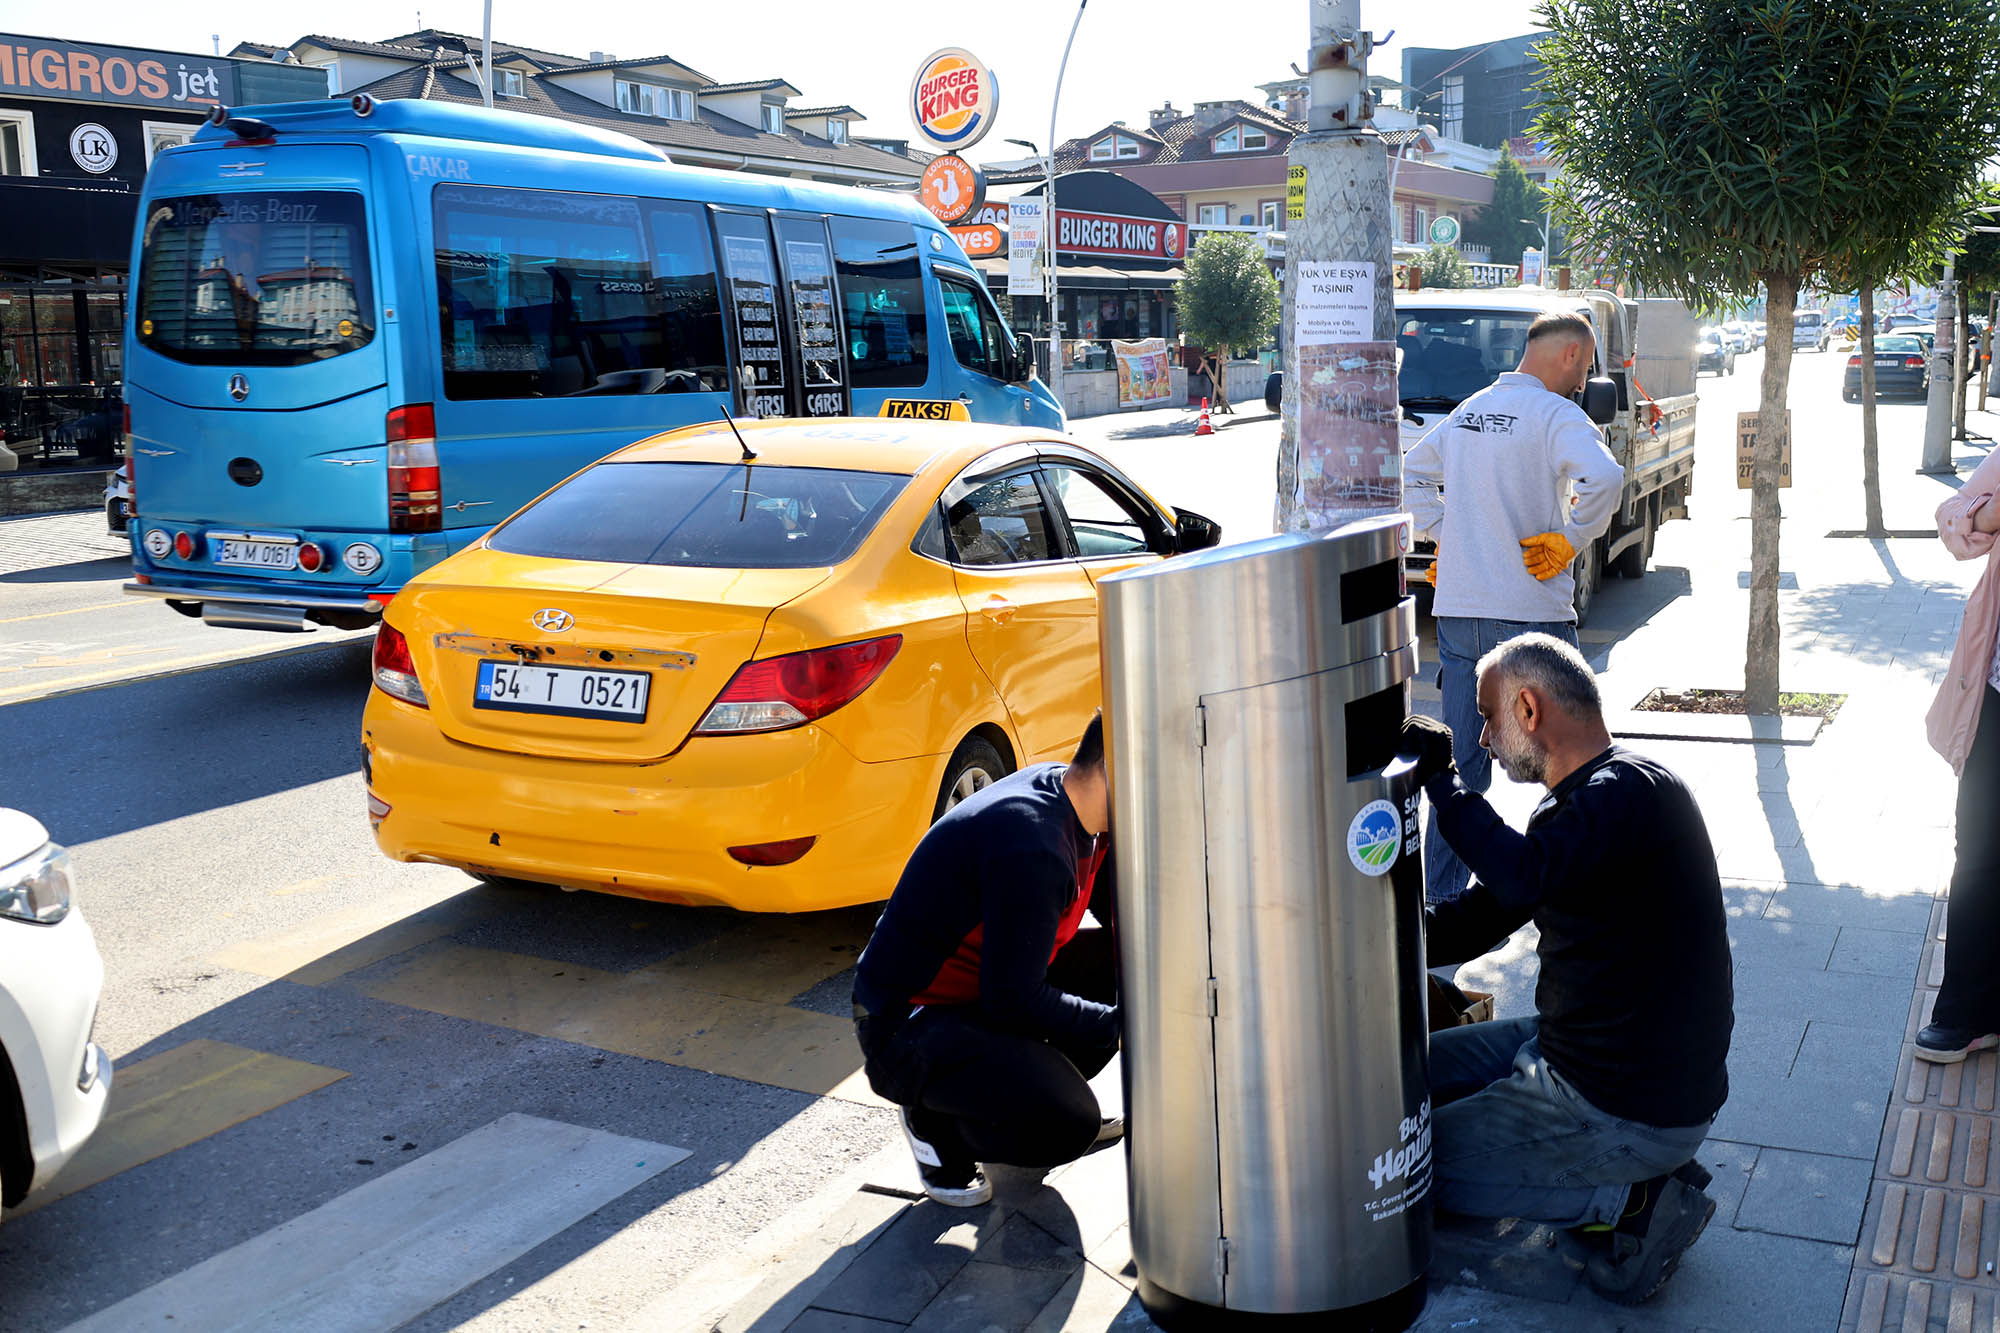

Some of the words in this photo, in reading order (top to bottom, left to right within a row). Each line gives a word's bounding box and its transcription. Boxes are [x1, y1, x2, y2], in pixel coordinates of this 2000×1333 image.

[173, 63, 219, 101] jet
[920, 68, 978, 103] BURGER
[922, 84, 979, 125] KING
[79, 139, 109, 156] LK
[407, 154, 471, 182] ÇAKAR
[927, 158, 969, 177] LOUISIANA
[173, 198, 319, 226] Mercedes-Benz
[929, 203, 967, 219] KITCHEN
[1010, 204, 1041, 216] TEOL
[1060, 216, 1120, 249] BURGER
[1121, 222, 1157, 252] KING
[1300, 268, 1320, 279] YÜK
[1322, 269, 1337, 278] VE
[1340, 269, 1368, 280] EŞYA
[1312, 284, 1354, 295] TAŞINIR
[1308, 320, 1331, 328] Mobilya
[222, 540, 239, 560] 54
[243, 542, 257, 562] M
[261, 543, 290, 565] 0161
[480, 683, 491, 695] TR
[493, 667, 520, 699] 54
[546, 672, 559, 702] T
[580, 675, 640, 709] 0521
[1399, 1115, 1418, 1143] Bu
[1364, 1201, 1380, 1212] T.C.
